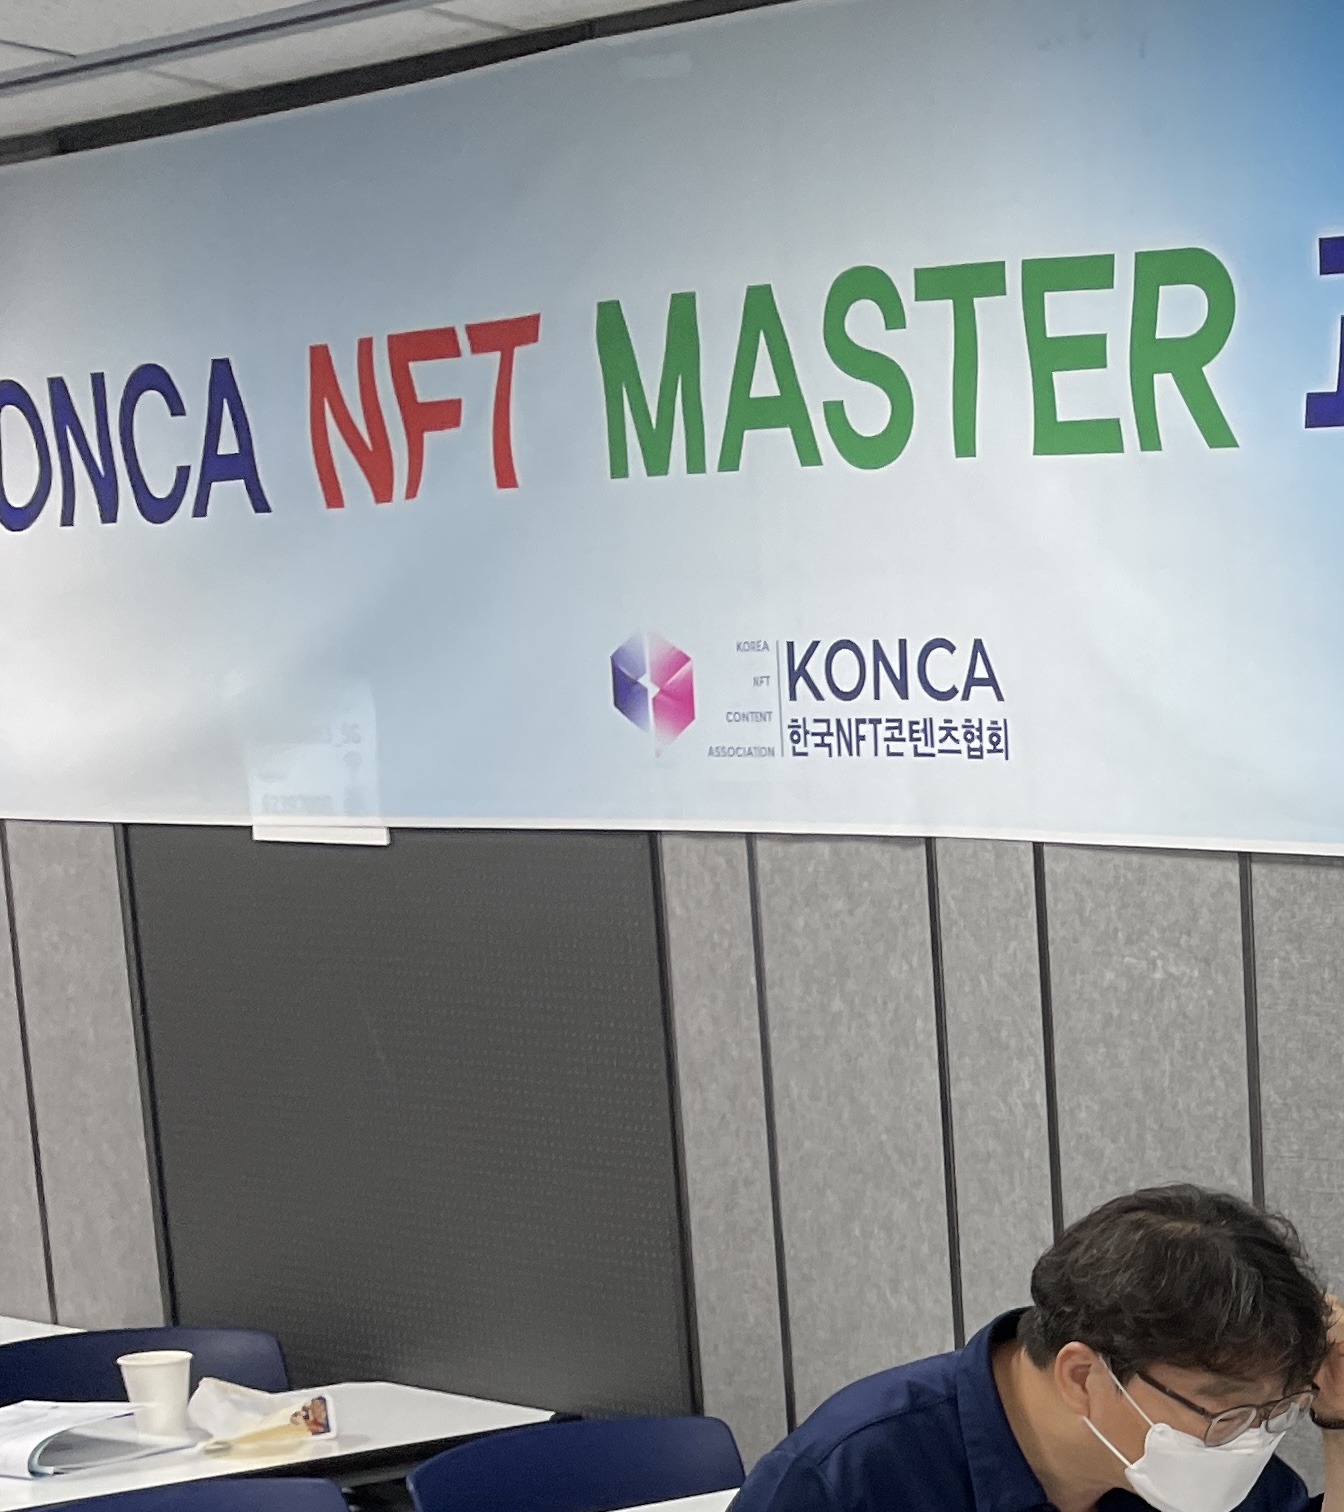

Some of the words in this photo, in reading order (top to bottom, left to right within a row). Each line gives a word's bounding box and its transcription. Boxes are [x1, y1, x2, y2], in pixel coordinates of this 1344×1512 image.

[308, 313, 541, 509] NFT
[596, 247, 1240, 478] MASTER
[735, 640, 770, 653] KOREA
[786, 638, 1005, 702] KONCA
[725, 711, 773, 724] CONTENT
[706, 744, 776, 758] ASSOCIATION
[787, 717, 1010, 760] 한국NFT콘텐츠협회
